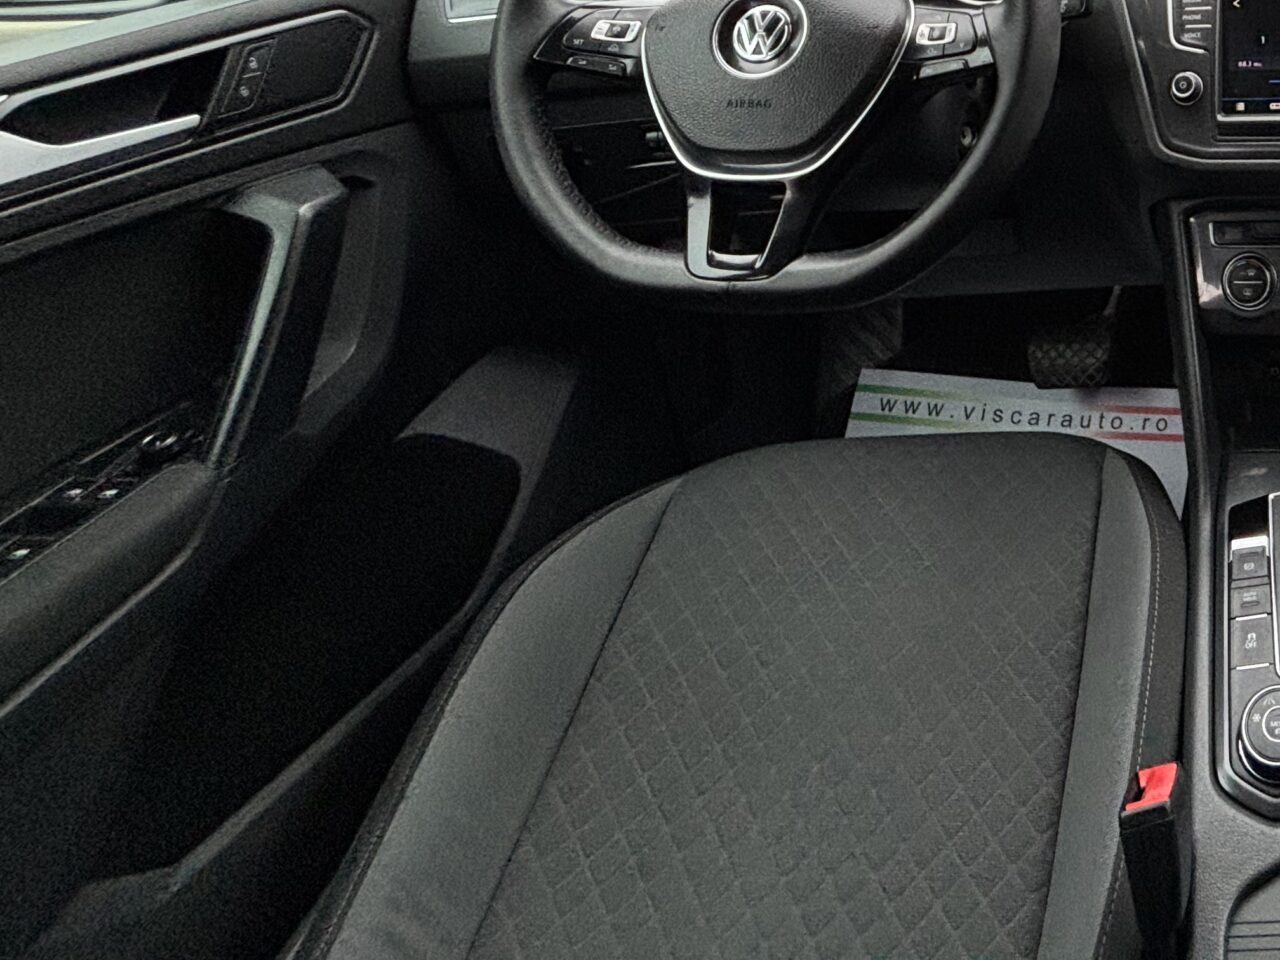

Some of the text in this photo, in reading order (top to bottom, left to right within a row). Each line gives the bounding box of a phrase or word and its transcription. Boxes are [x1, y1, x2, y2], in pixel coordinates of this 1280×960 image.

[1261, 35, 1266, 45] 1
[725, 99, 773, 109] AIRBAG
[879, 396, 1169, 432] www.viscarauto.ro
